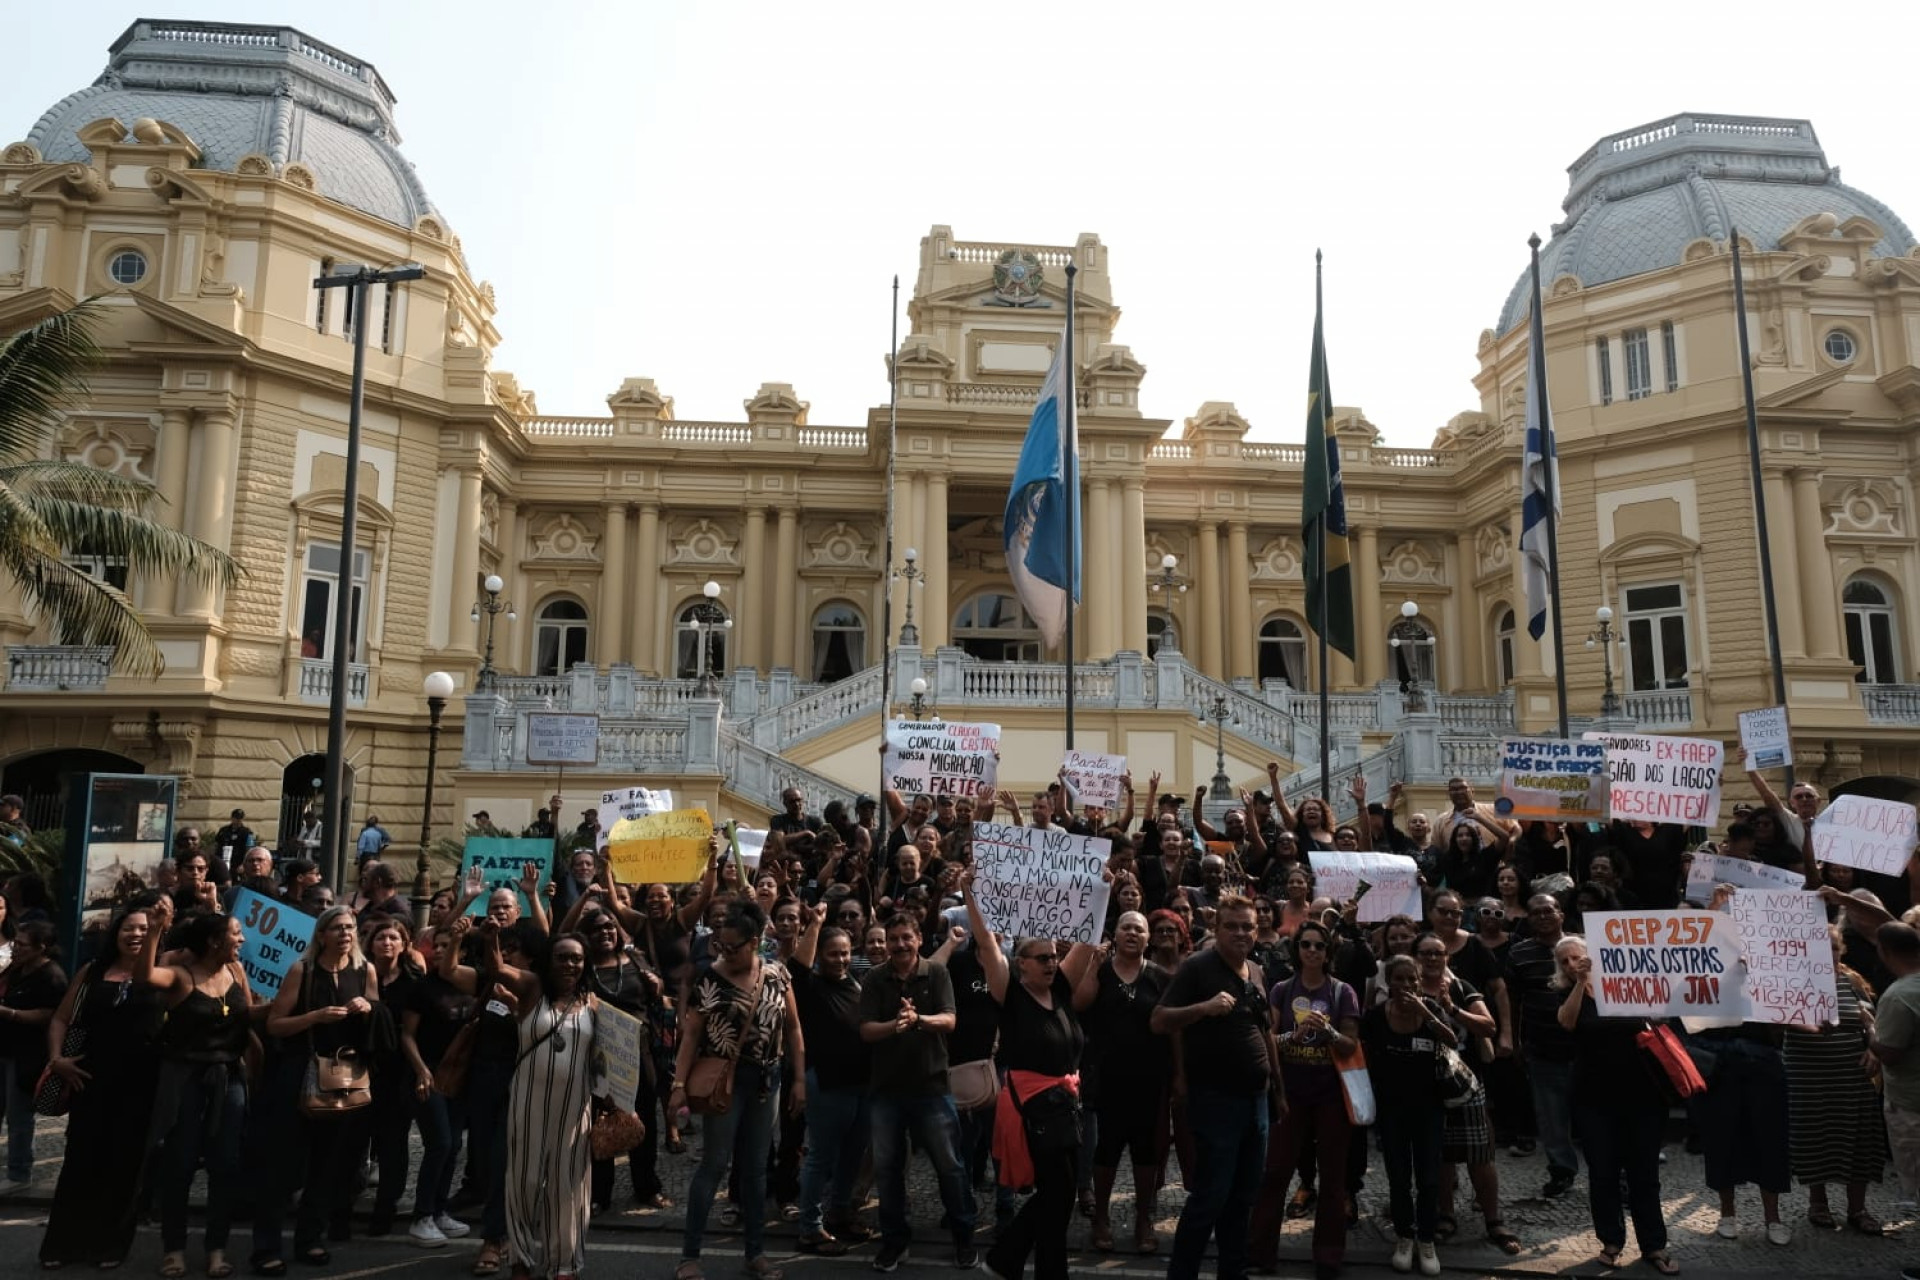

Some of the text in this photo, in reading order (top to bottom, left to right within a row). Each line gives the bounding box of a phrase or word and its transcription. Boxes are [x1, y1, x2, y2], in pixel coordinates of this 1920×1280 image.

[898, 722, 946, 731] GOVERNADOR
[908, 736, 956, 752] CONCLUA
[1506, 741, 1603, 757] JUSTIÇA PRA
[1656, 741, 1706, 763] EX-FAEP
[898, 752, 985, 776] NOSSA MIGRAÇÃO
[1503, 756, 1532, 771] NÓS
[1535, 760, 1552, 773] EX
[1608, 757, 1716, 790] GIÃO DOS LAGOS
[893, 776, 985, 796] SOMOS FAETEC
[1609, 789, 1710, 821] RESENTES!!
[1043, 832, 1072, 852] NÃO
[1011, 867, 1021, 882] A
[1026, 868, 1059, 887] MÃO
[1069, 874, 1093, 893] NA
[1079, 893, 1090, 908] E
[1733, 893, 1815, 910] EM NOME
[981, 896, 1094, 929] SSINA LOGO A
[1734, 909, 1817, 925] DE TODOS
[246, 899, 309, 953] 30 ANO
[990, 918, 1092, 943] SSA MIGRAÇÃO
[1605, 917, 1714, 946] CIEP 257
[258, 943, 282, 964] DE
[1768, 940, 1808, 957] 1994
[1600, 947, 1724, 974] RIO DAS OSTRAS
[1602, 974, 1720, 1007] MIGRAÇÃO JÁ!
